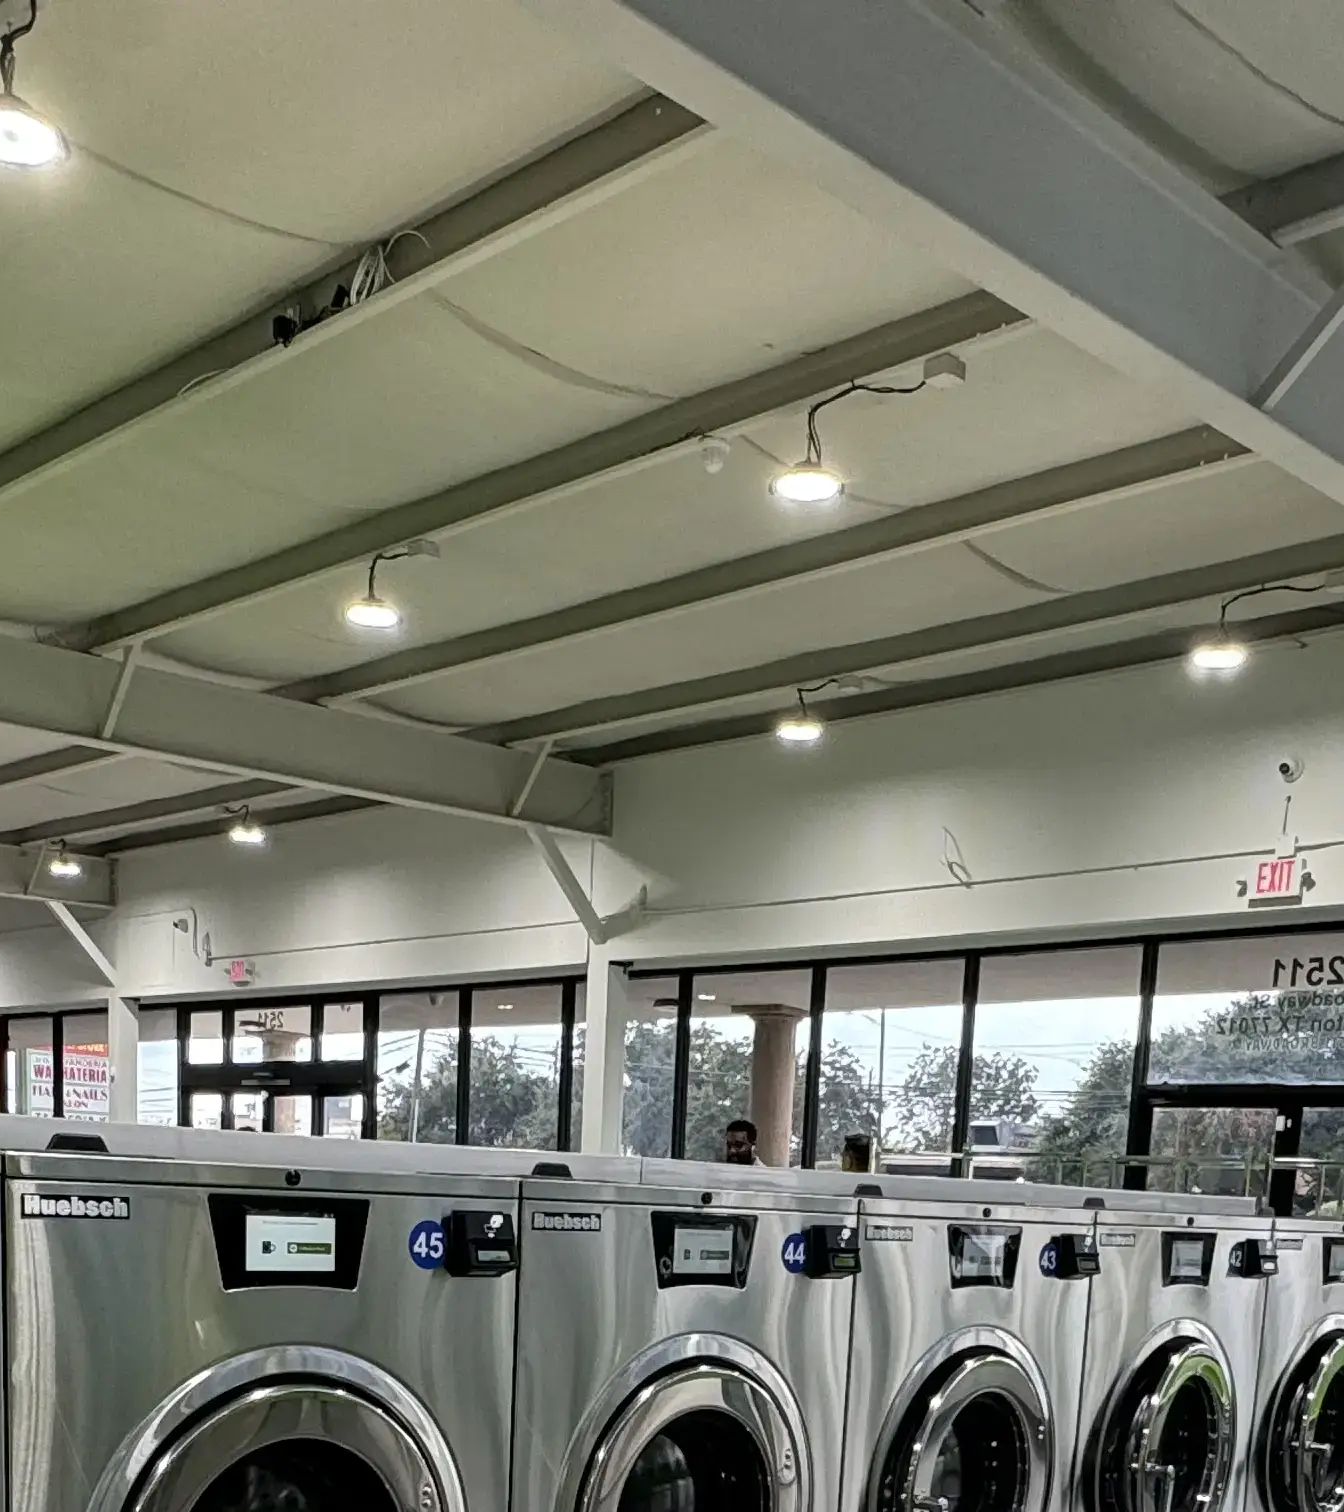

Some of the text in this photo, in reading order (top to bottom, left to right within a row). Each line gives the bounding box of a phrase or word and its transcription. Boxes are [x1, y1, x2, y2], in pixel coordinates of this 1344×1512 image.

[1256, 861, 1295, 893] EXIT
[23, 1194, 129, 1218] Huebsch
[533, 1212, 600, 1230] Huebsch
[412, 1231, 445, 1259] 45
[784, 1242, 806, 1265] 44
[1040, 1250, 1057, 1270] 43
[1230, 1250, 1243, 1268] 42
